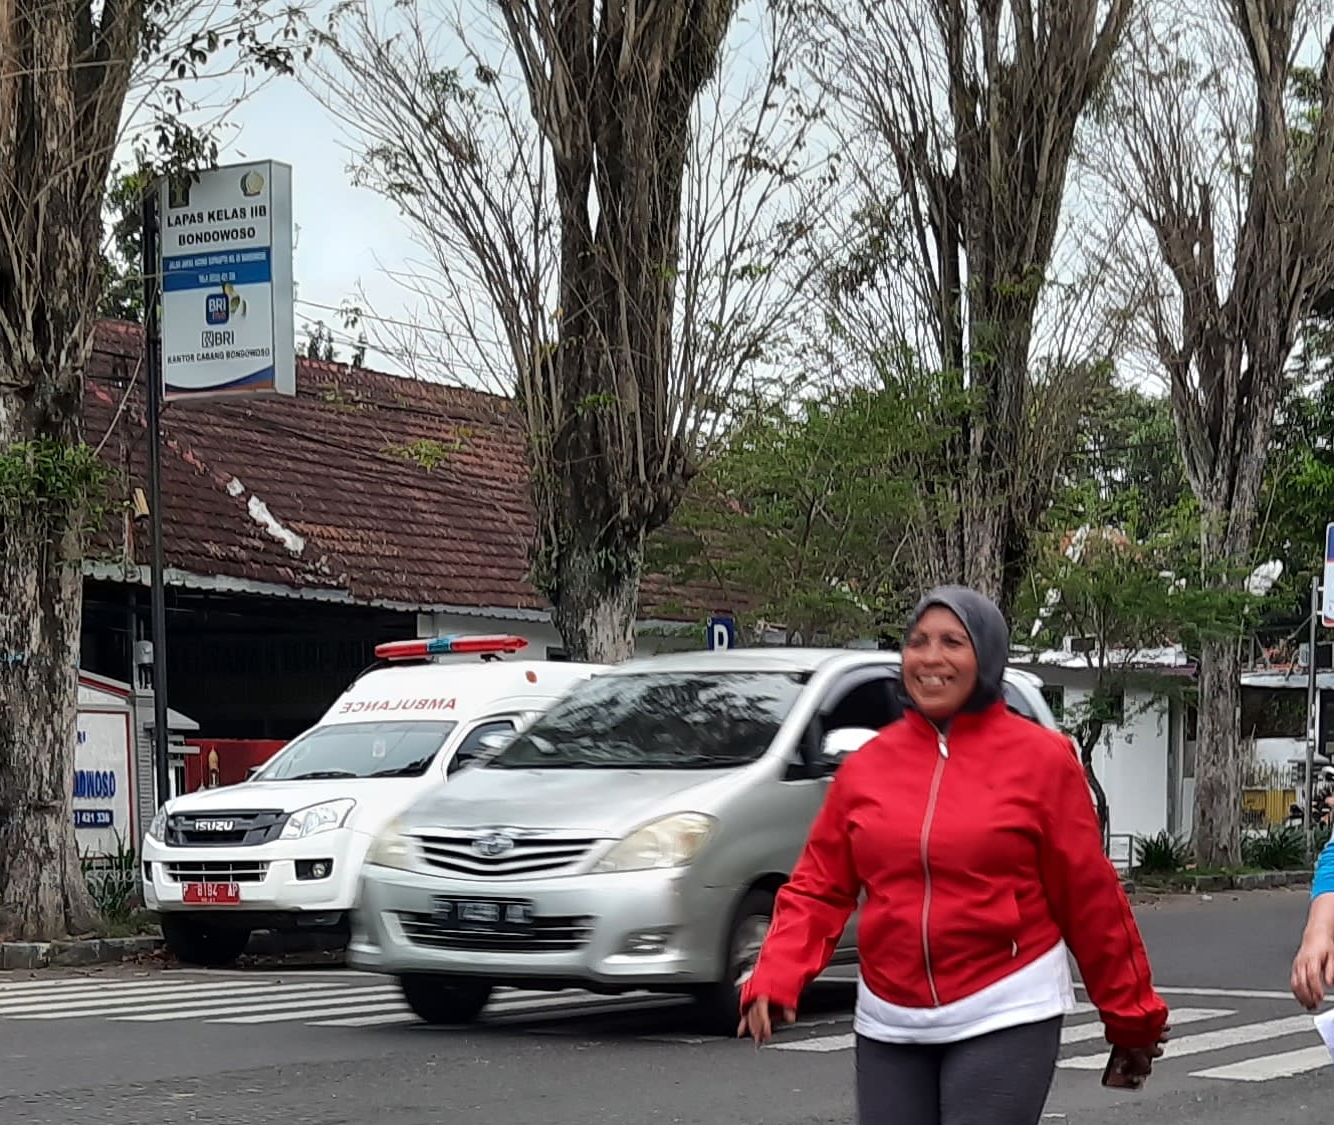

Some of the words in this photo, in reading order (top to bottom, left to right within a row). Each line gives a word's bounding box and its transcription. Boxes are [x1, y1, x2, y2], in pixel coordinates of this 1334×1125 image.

[168, 211, 204, 228] LAPAS
[208, 207, 247, 224] KELAS
[251, 205, 267, 218] IIB
[179, 227, 256, 246] BONDOWOSO
[209, 298, 226, 312] BRI
[215, 330, 235, 345] BRI
[168, 353, 195, 364] KANTOR
[195, 821, 233, 831] ISUZU
